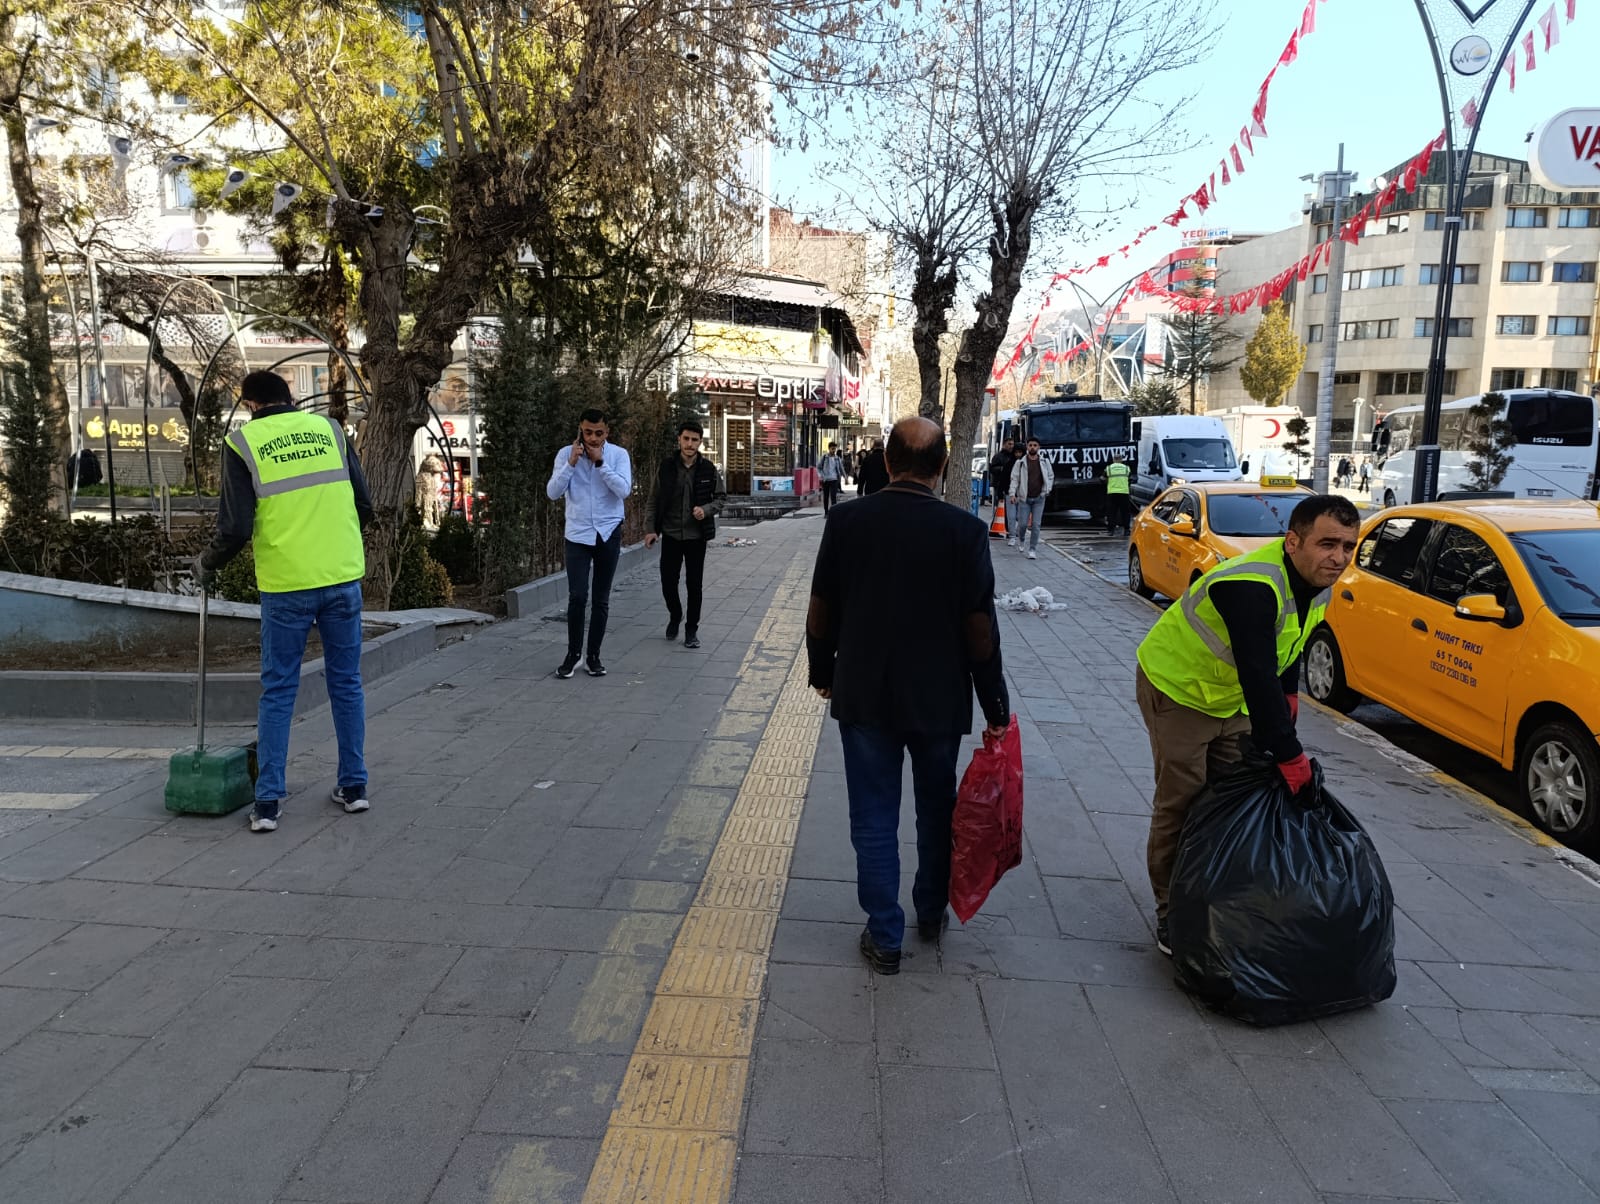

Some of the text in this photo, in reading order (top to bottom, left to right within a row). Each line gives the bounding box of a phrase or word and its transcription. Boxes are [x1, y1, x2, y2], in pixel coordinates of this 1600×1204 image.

[757, 375, 821, 403] Optik
[109, 419, 158, 438] Appe
[256, 434, 291, 461] İPEKYOLU
[291, 430, 334, 448] BELEDİYESİ
[271, 446, 328, 464] TEMİZLİK
[1038, 446, 1136, 464] EVİK KUVVET
[1434, 629, 1460, 646] MURAT
[1436, 650, 1445, 660] 65
[1454, 656, 1473, 672] 0604
